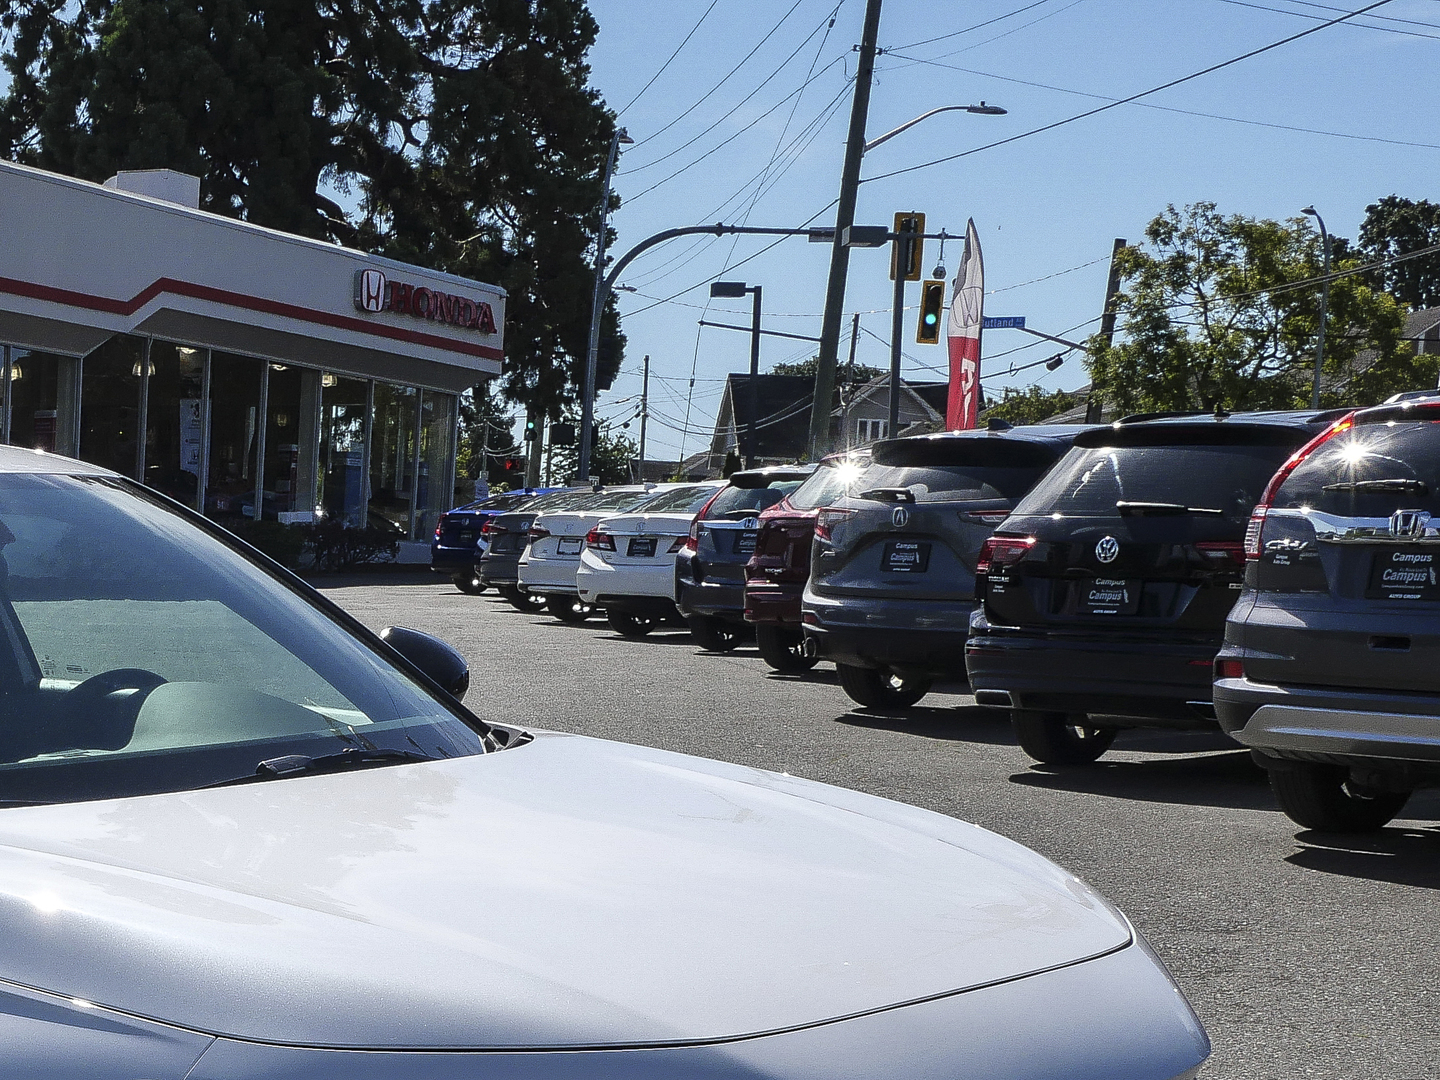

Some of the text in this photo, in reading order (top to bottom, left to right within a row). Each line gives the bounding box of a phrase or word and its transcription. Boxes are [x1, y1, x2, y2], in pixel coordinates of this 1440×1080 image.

[387, 280, 498, 334] HONDA
[1392, 552, 1433, 564] Campus
[1095, 577, 1126, 587] Campus
[1382, 568, 1428, 584] Campus
[1089, 590, 1122, 602] Campus
